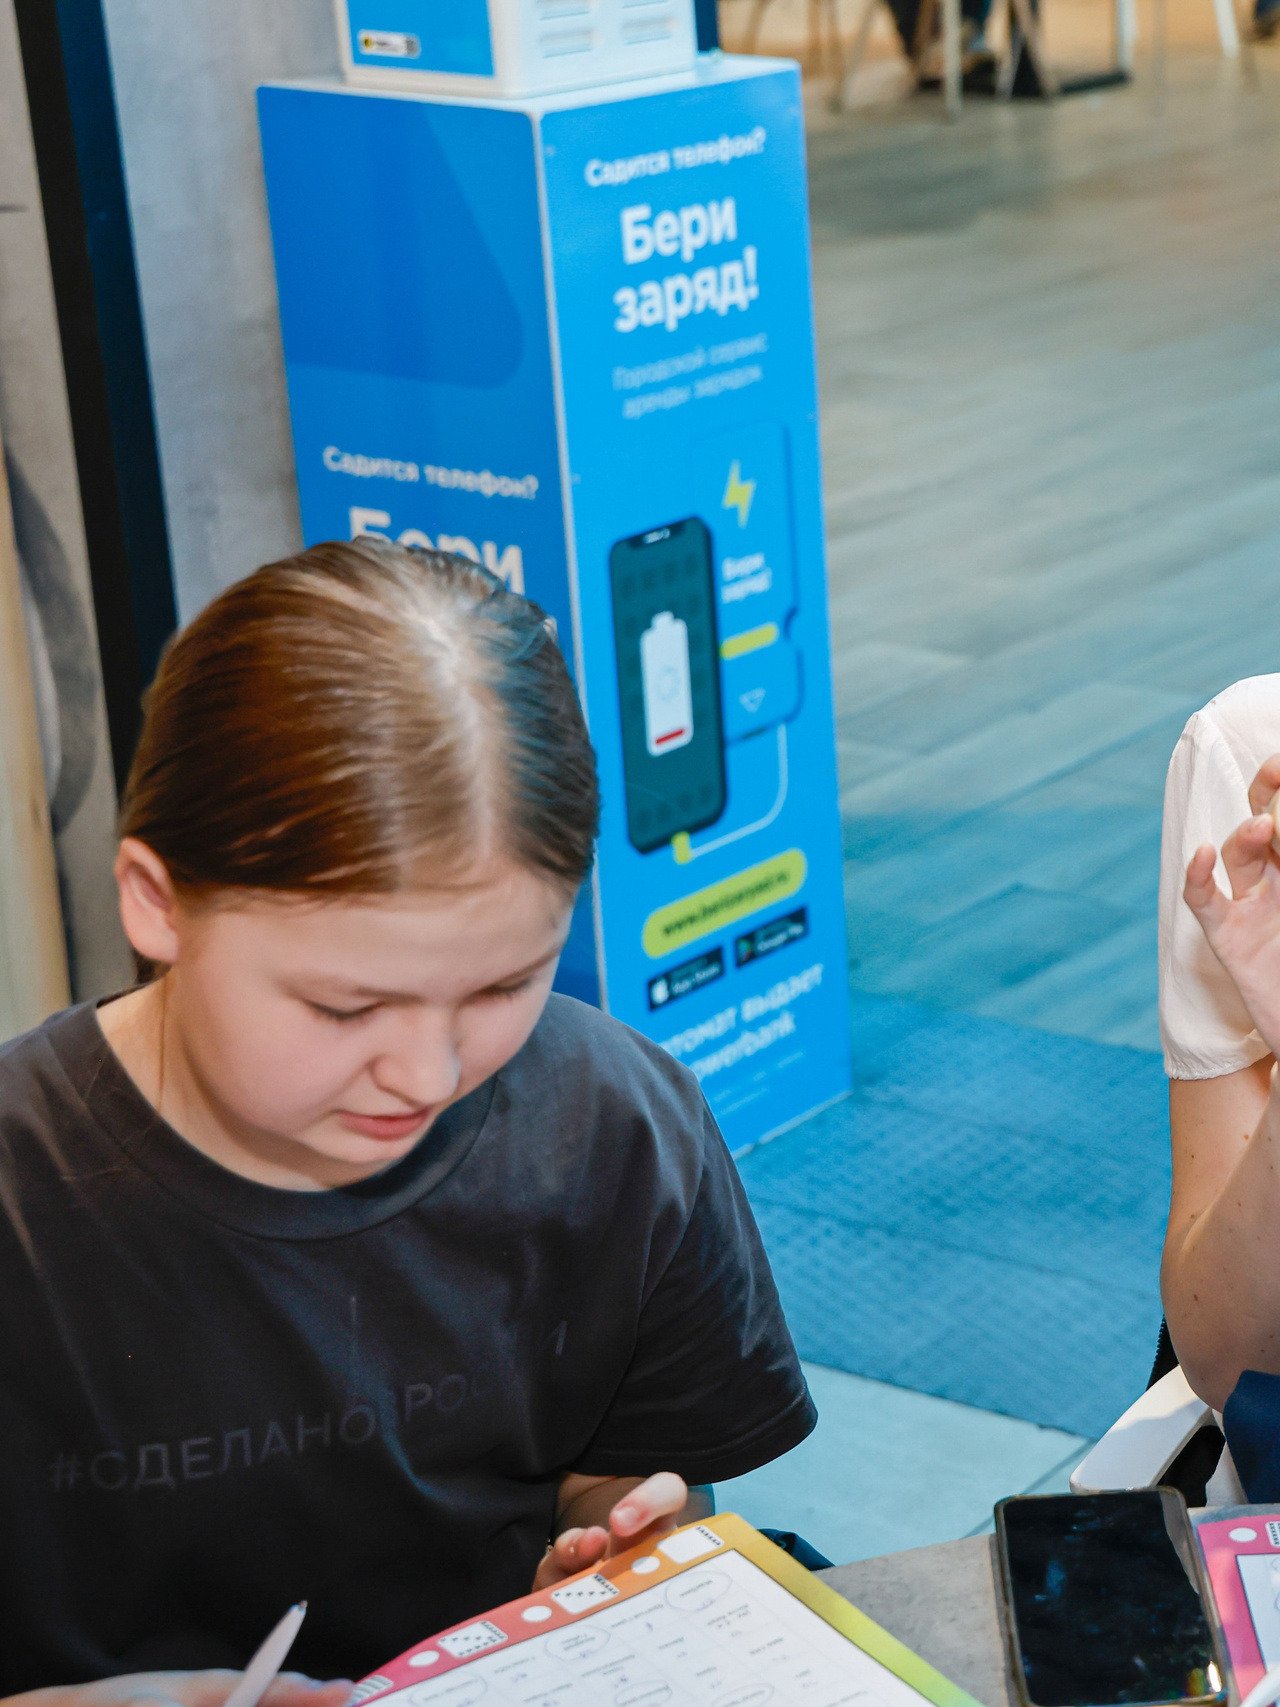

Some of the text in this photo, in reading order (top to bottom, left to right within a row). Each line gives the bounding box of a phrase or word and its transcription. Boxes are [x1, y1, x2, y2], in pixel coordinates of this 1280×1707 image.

[584, 126, 766, 187] Садится телефон?
[621, 197, 737, 265] Бери
[613, 245, 759, 333] заряд!
[323, 446, 539, 500] Садится телефон?
